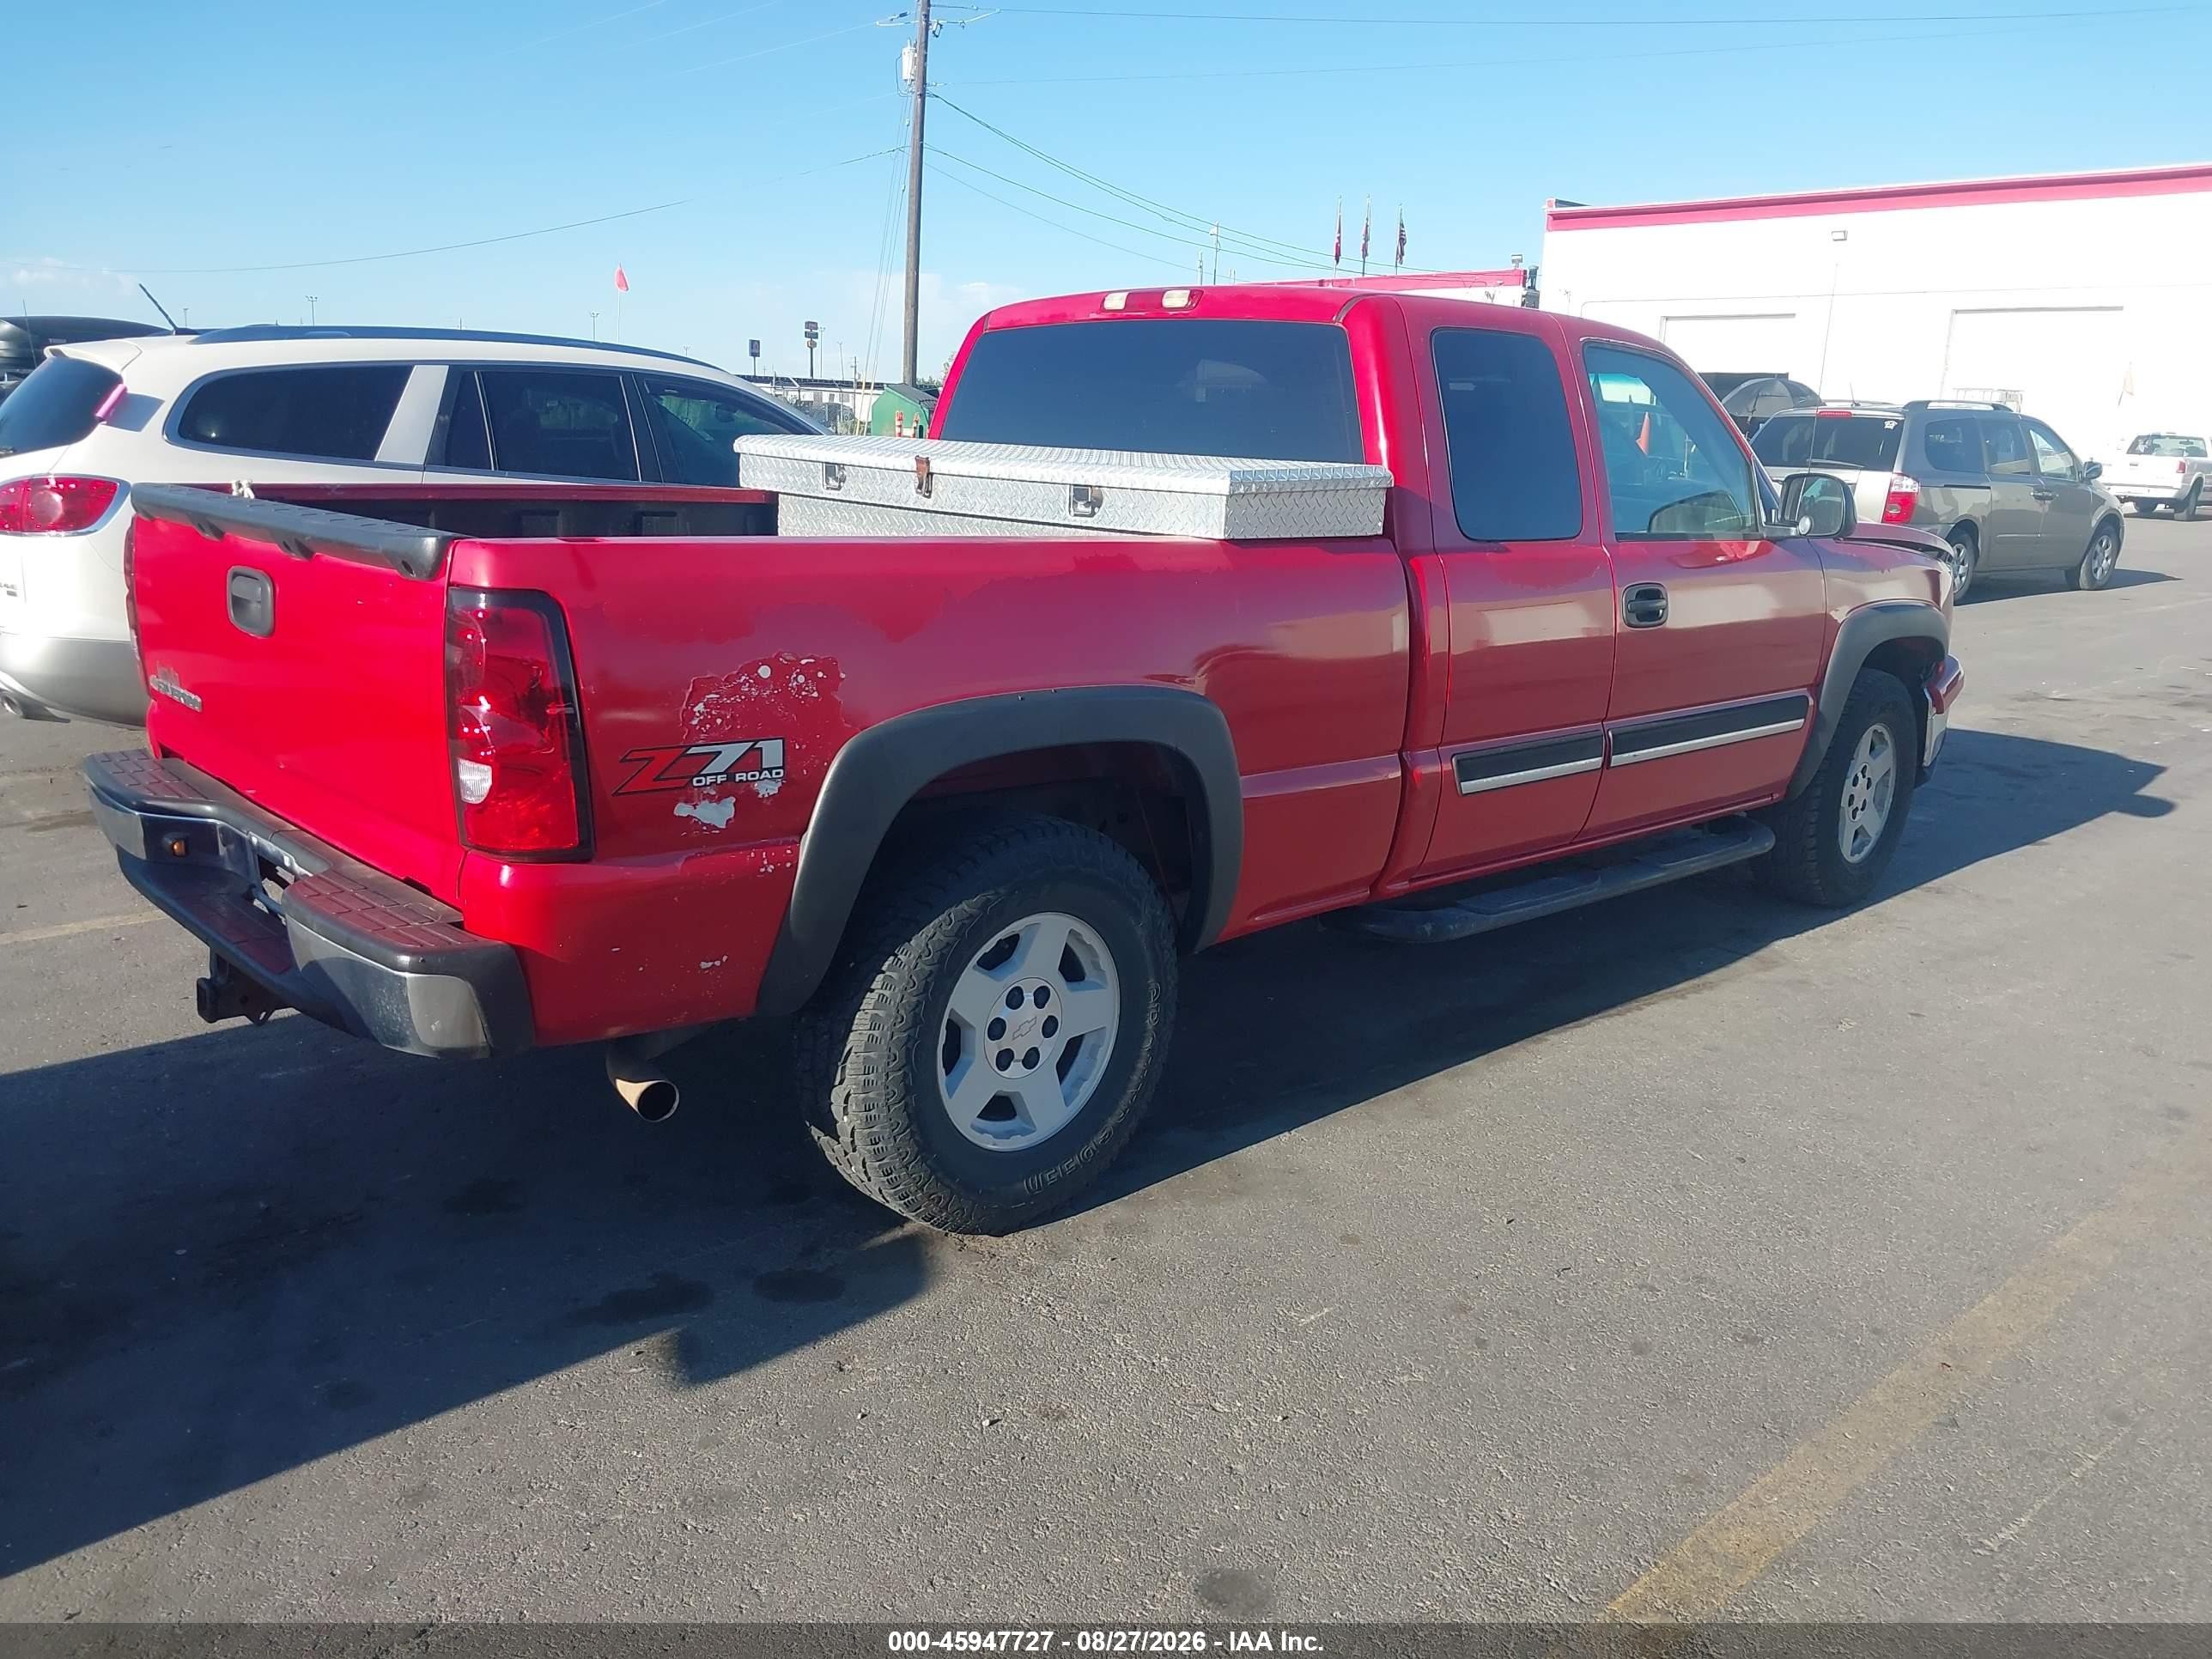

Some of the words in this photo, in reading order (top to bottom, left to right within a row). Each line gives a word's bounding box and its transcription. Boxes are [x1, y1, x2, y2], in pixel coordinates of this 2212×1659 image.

[611, 737, 785, 797] Z71
[692, 774, 727, 787] OFF
[734, 769, 785, 782] ROAD
